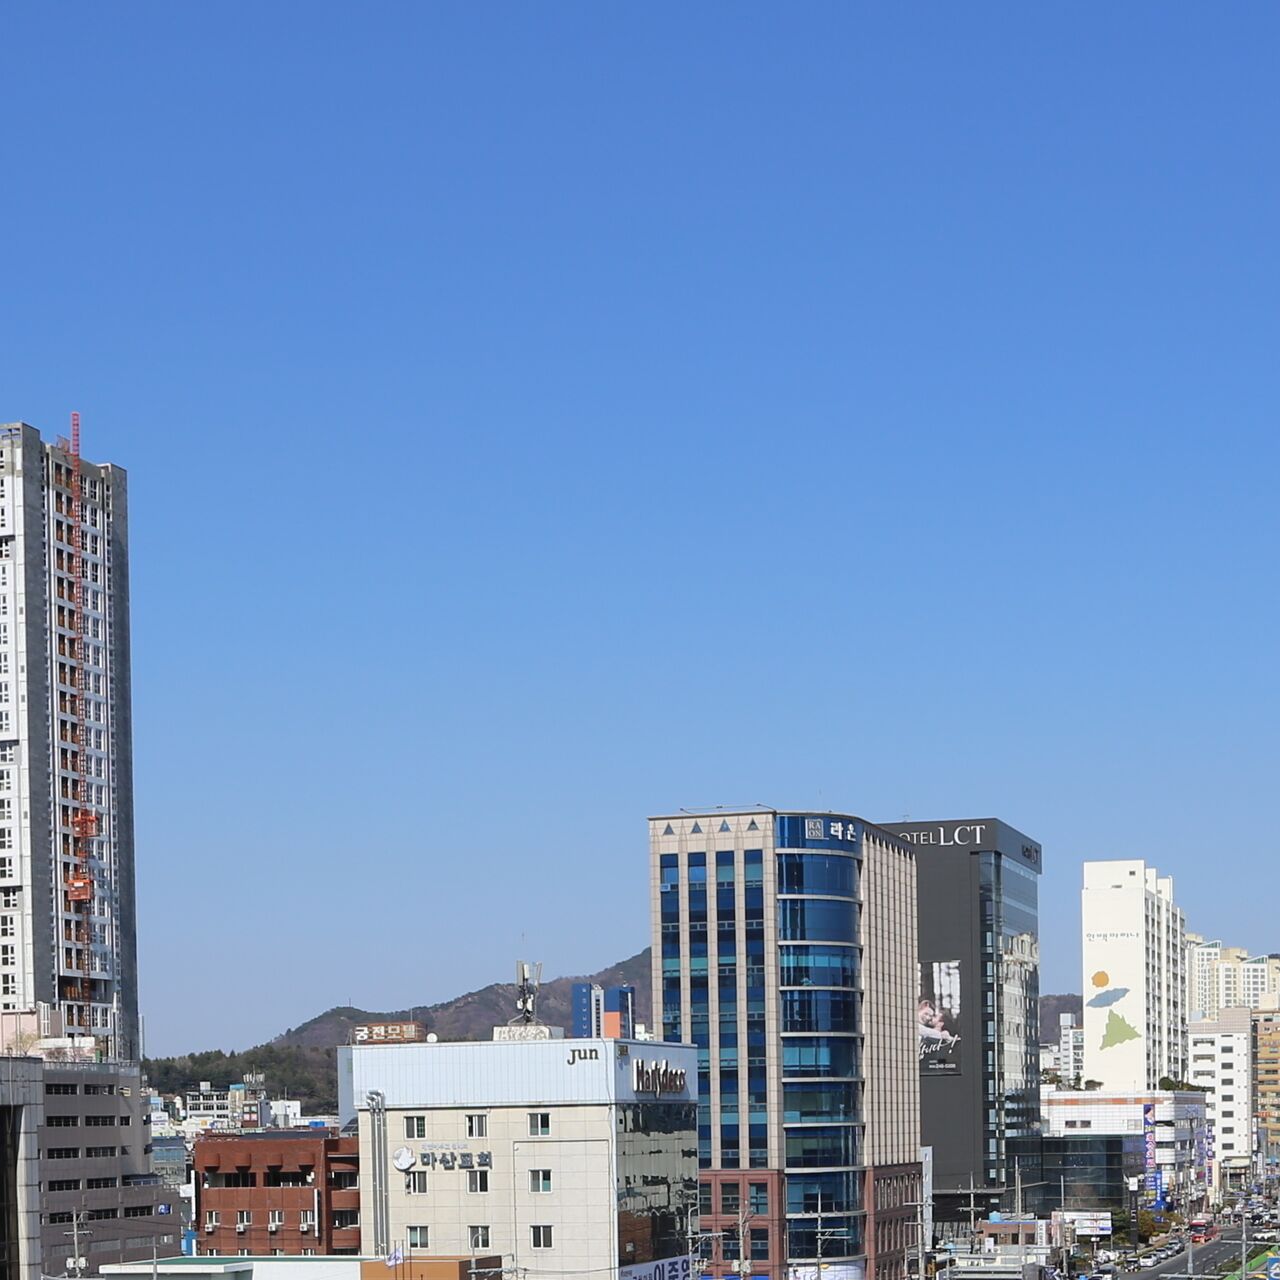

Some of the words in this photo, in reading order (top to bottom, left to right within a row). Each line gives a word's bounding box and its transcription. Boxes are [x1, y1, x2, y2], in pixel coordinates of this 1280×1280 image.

[830, 822, 857, 842] 라온
[899, 831, 937, 846] OTEL
[938, 825, 985, 846] LCT
[355, 1025, 416, 1041] 궁전모텔
[421, 1152, 493, 1171] 마산교회
